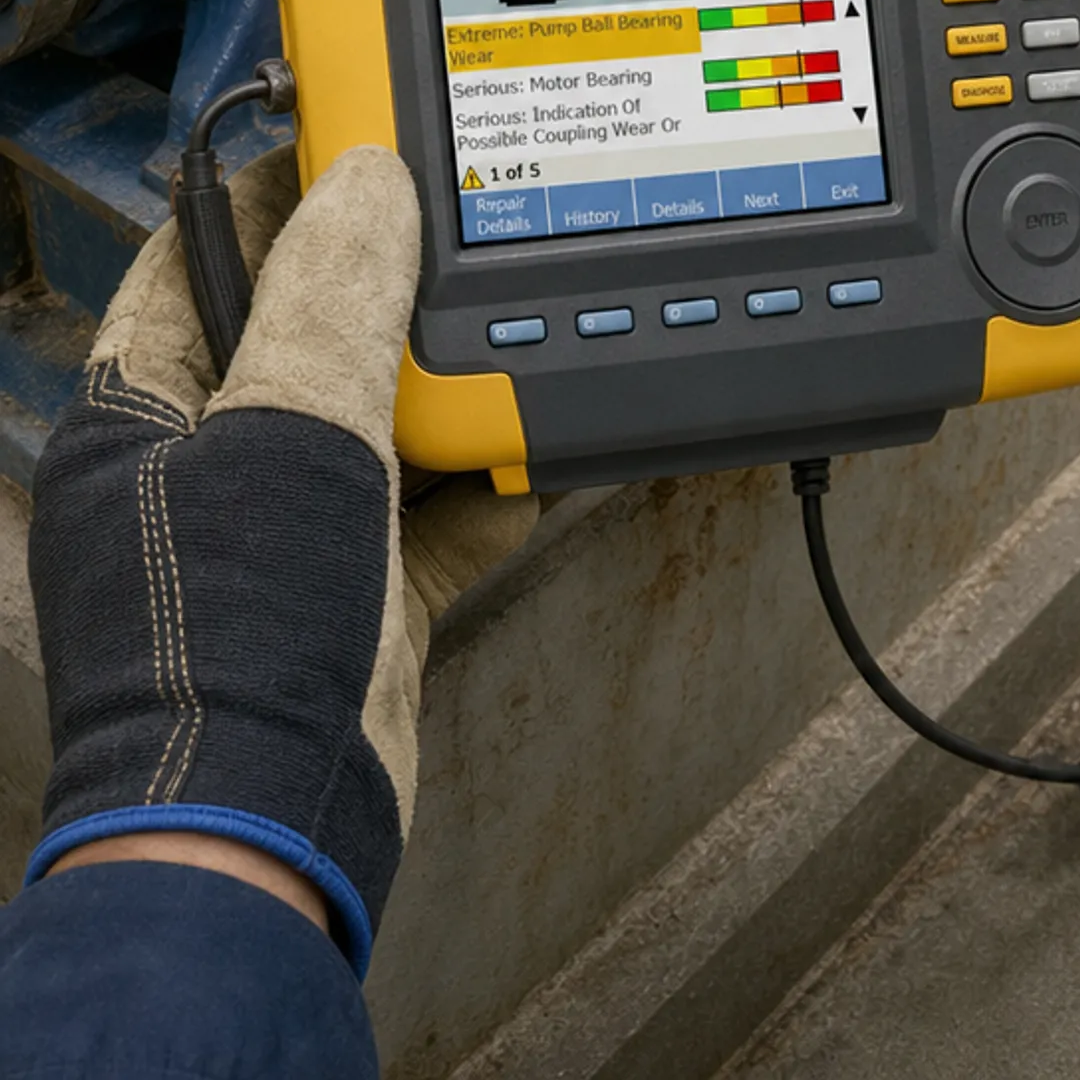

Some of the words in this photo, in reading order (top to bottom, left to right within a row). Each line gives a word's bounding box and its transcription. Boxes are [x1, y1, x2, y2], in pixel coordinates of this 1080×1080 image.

[447, 23, 524, 46] Extreme:
[529, 19, 577, 38] Pump
[582, 16, 613, 32] Ball
[618, 12, 683, 32] Bearing
[449, 49, 494, 66] Wear
[453, 79, 524, 99] Serious:
[530, 73, 581, 92] Motor
[586, 69, 652, 90] Bearing
[456, 110, 527, 129] Serious:
[533, 102, 618, 122] Indication
[622, 98, 641, 116] Of
[458, 131, 527, 151] Possible
[533, 124, 607, 147] Coupling
[612, 120, 656, 138] Wear
[661, 117, 681, 134] Or
[490, 167, 500, 182] 1
[506, 164, 524, 181] of
[529, 163, 540, 178] 5
[744, 192, 780, 208] Next
[831, 183, 859, 200] Exit
[652, 199, 705, 218] Details
[477, 217, 531, 236] Details
[564, 210, 620, 228] History
[1025, 211, 1069, 230] ENTER
